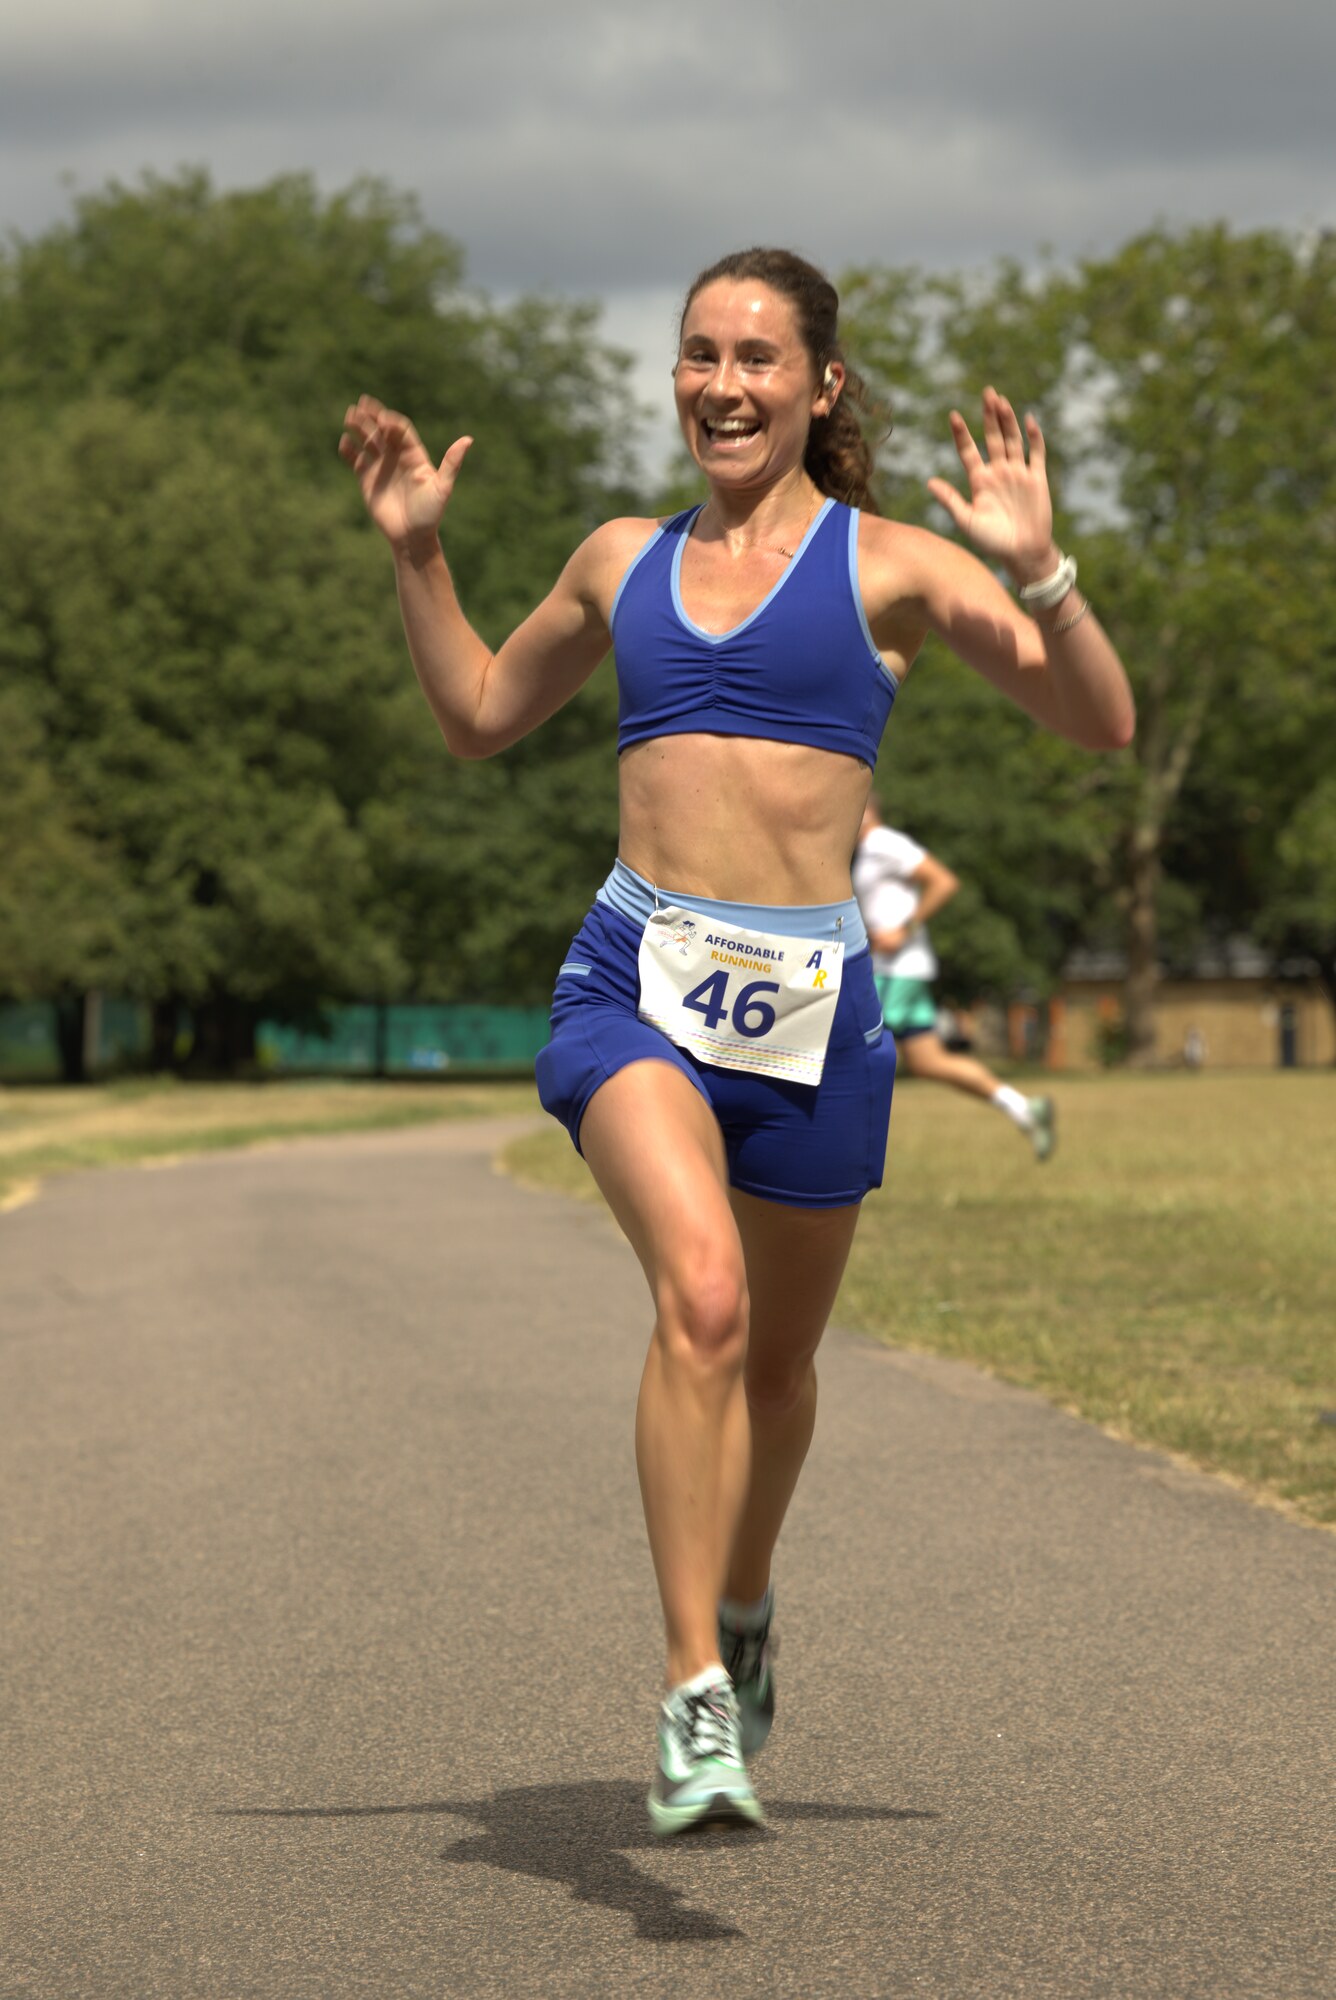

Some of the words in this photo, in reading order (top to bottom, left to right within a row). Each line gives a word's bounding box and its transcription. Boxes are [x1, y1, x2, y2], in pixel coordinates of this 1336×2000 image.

[705, 934, 785, 962] AFFORDABLE
[806, 950, 823, 970] A
[711, 950, 772, 974] RUNNING
[812, 969, 829, 989] R
[682, 970, 780, 1038] 46
